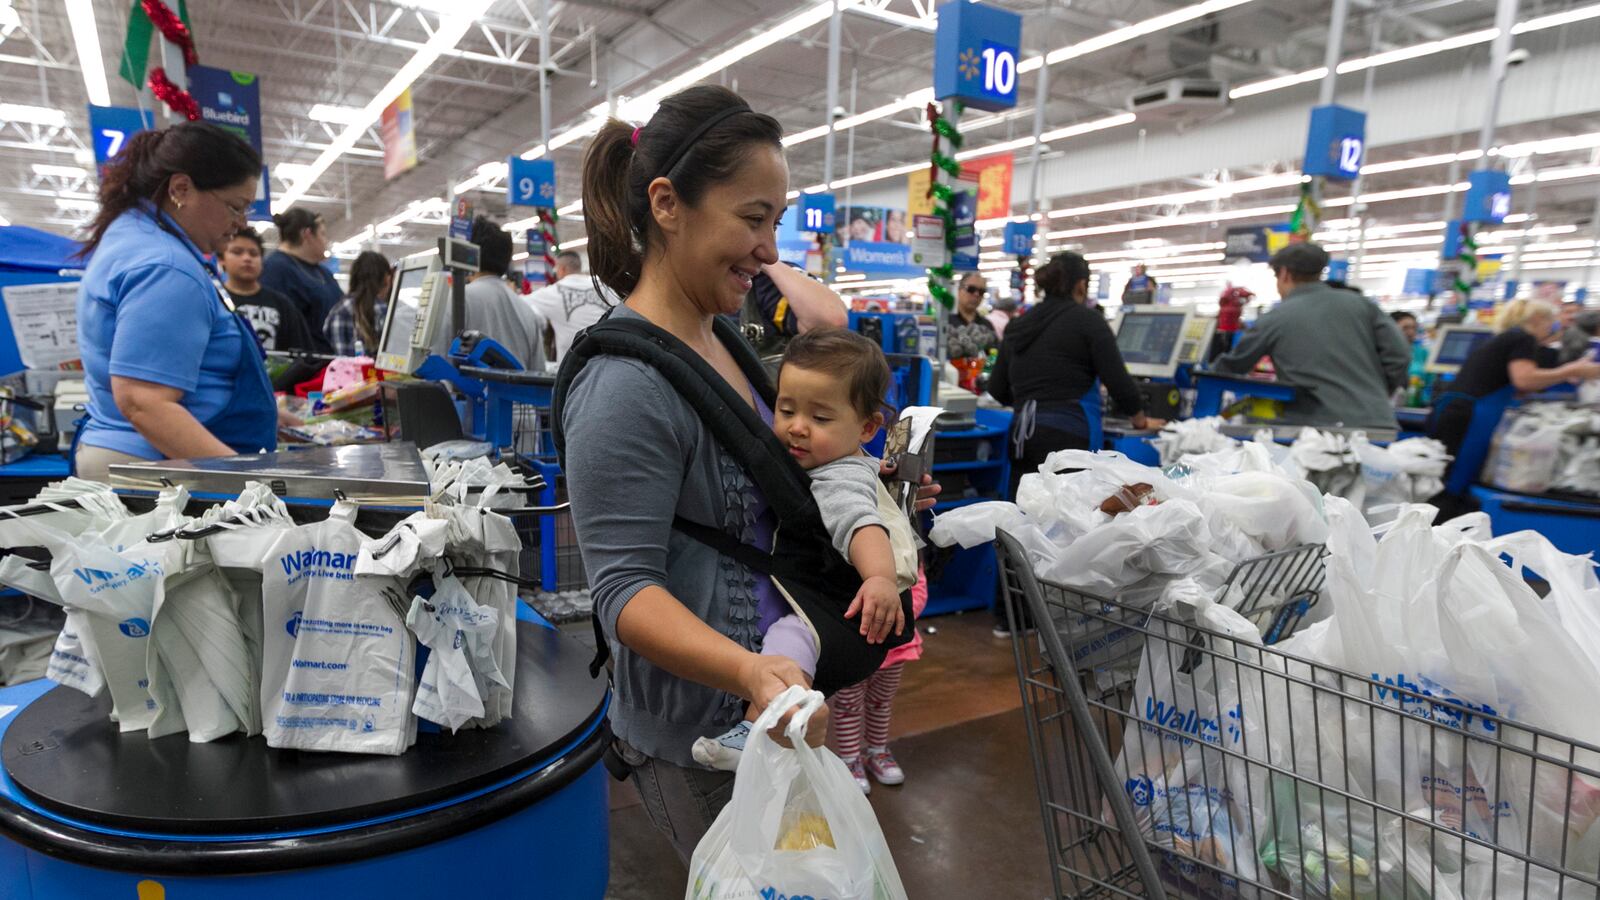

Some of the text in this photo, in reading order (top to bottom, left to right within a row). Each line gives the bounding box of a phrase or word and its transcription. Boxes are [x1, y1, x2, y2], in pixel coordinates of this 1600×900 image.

[982, 47, 1015, 95] 10
[202, 107, 249, 126] Bluebird
[102, 129, 124, 157] 7
[1340, 137, 1361, 173] 12
[519, 177, 534, 199] 9
[805, 208, 822, 228] 11
[318, 569, 334, 578] Live
[334, 621, 352, 629] more
[361, 624, 379, 632] every
[380, 624, 393, 634] bag
